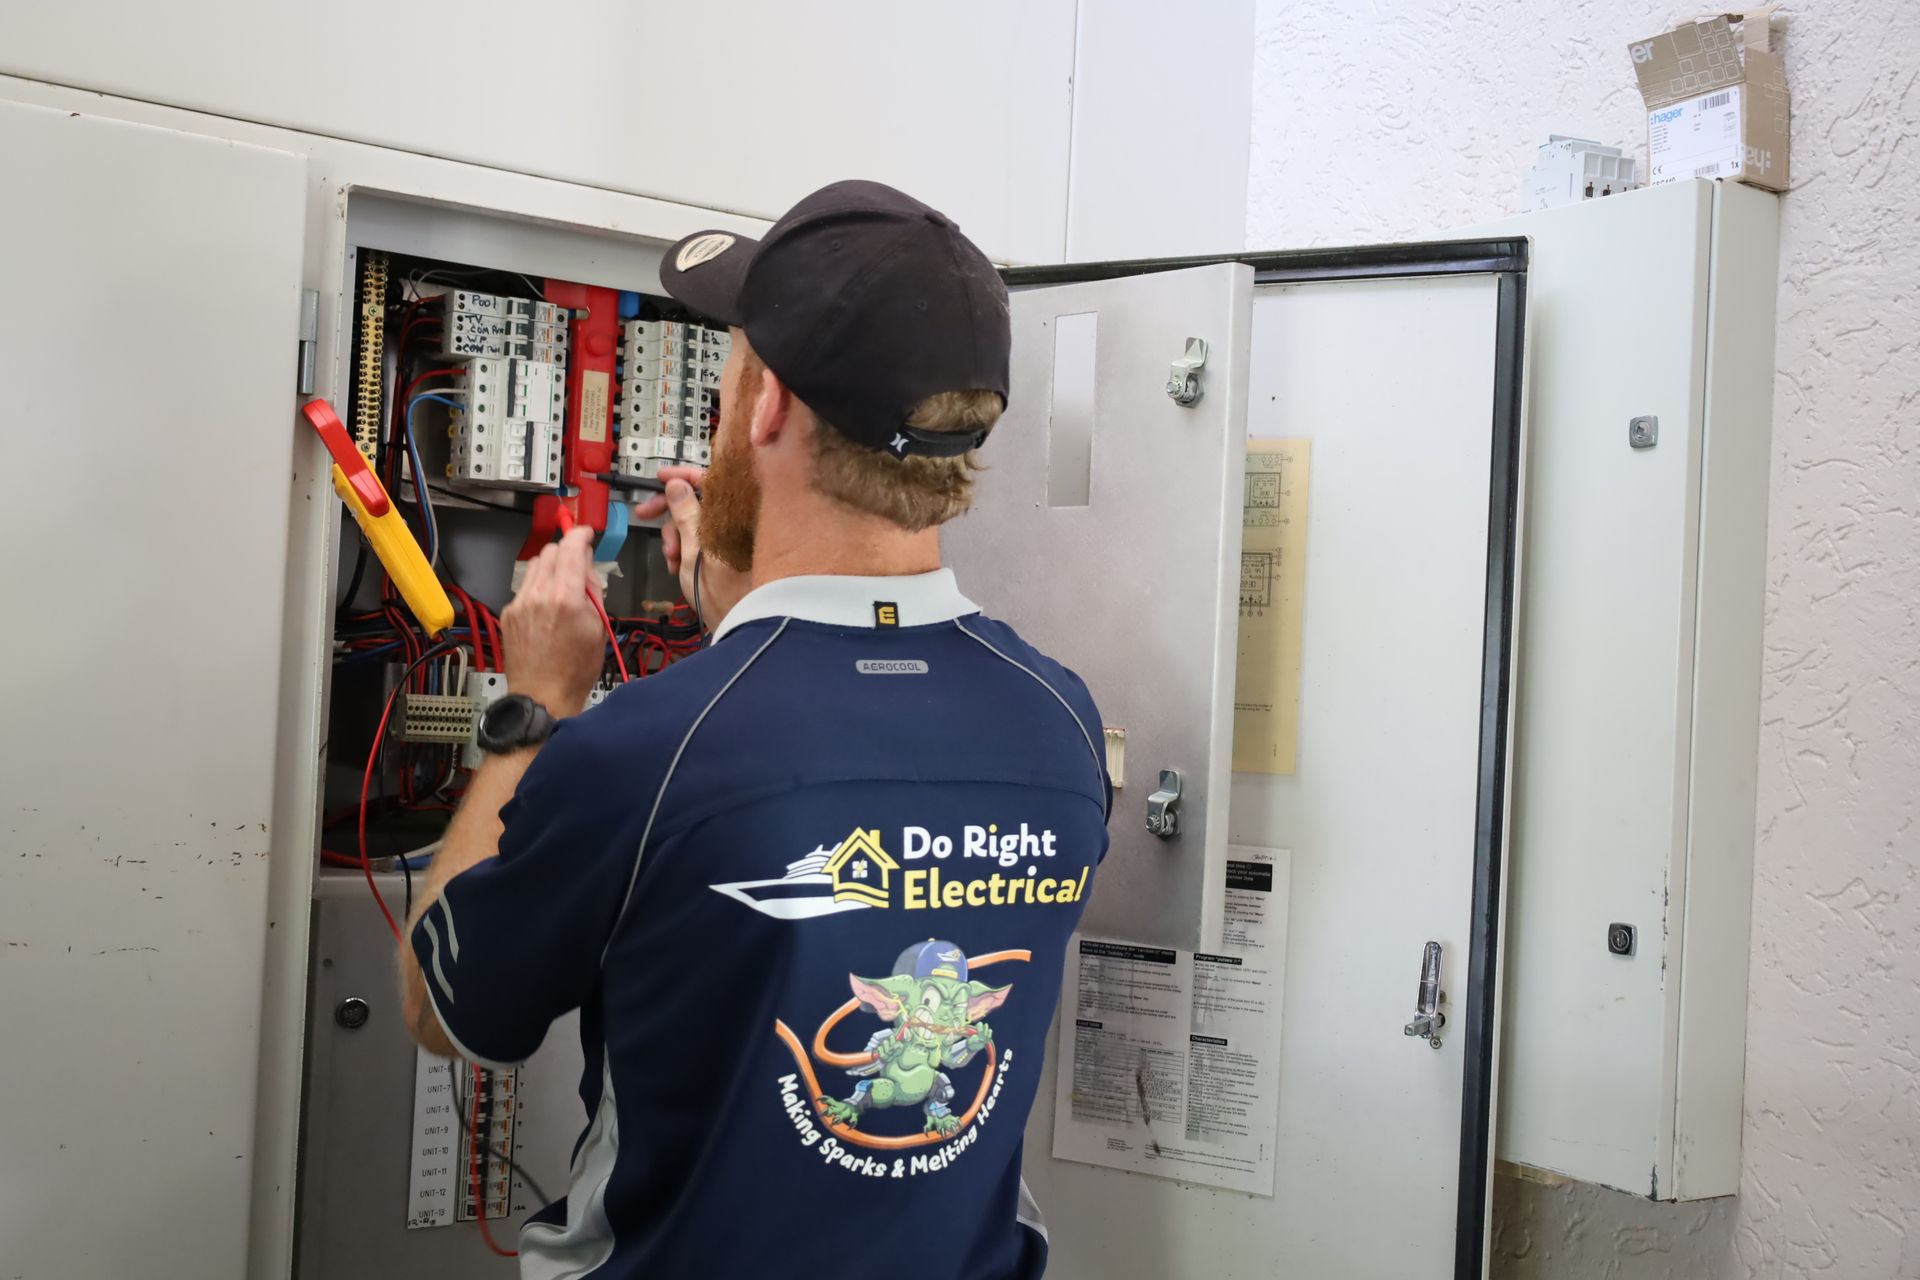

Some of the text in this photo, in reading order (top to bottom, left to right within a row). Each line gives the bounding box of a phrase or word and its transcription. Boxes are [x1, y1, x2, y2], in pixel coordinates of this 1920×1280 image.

[471, 294, 497, 309] Pool
[863, 662, 921, 671] AEROCOOL
[903, 822, 1057, 867] Do Right
[904, 865, 1089, 910] Electrical
[427, 1084, 451, 1093] UNIT-7
[426, 1105, 450, 1114] UNIT-8
[777, 1073, 821, 1146] Making
[819, 1137, 887, 1178] Sparks
[891, 1158, 906, 1178] &
[910, 1125, 978, 1175] Melting
[976, 1048, 1013, 1125] Hearts
[424, 1126, 449, 1136] UNIT-9
[422, 1147, 449, 1157] UNIT-10
[422, 1168, 447, 1177] UNIT-11
[420, 1188, 446, 1198] UNIT-12
[418, 1209, 445, 1218] UNIT-13
